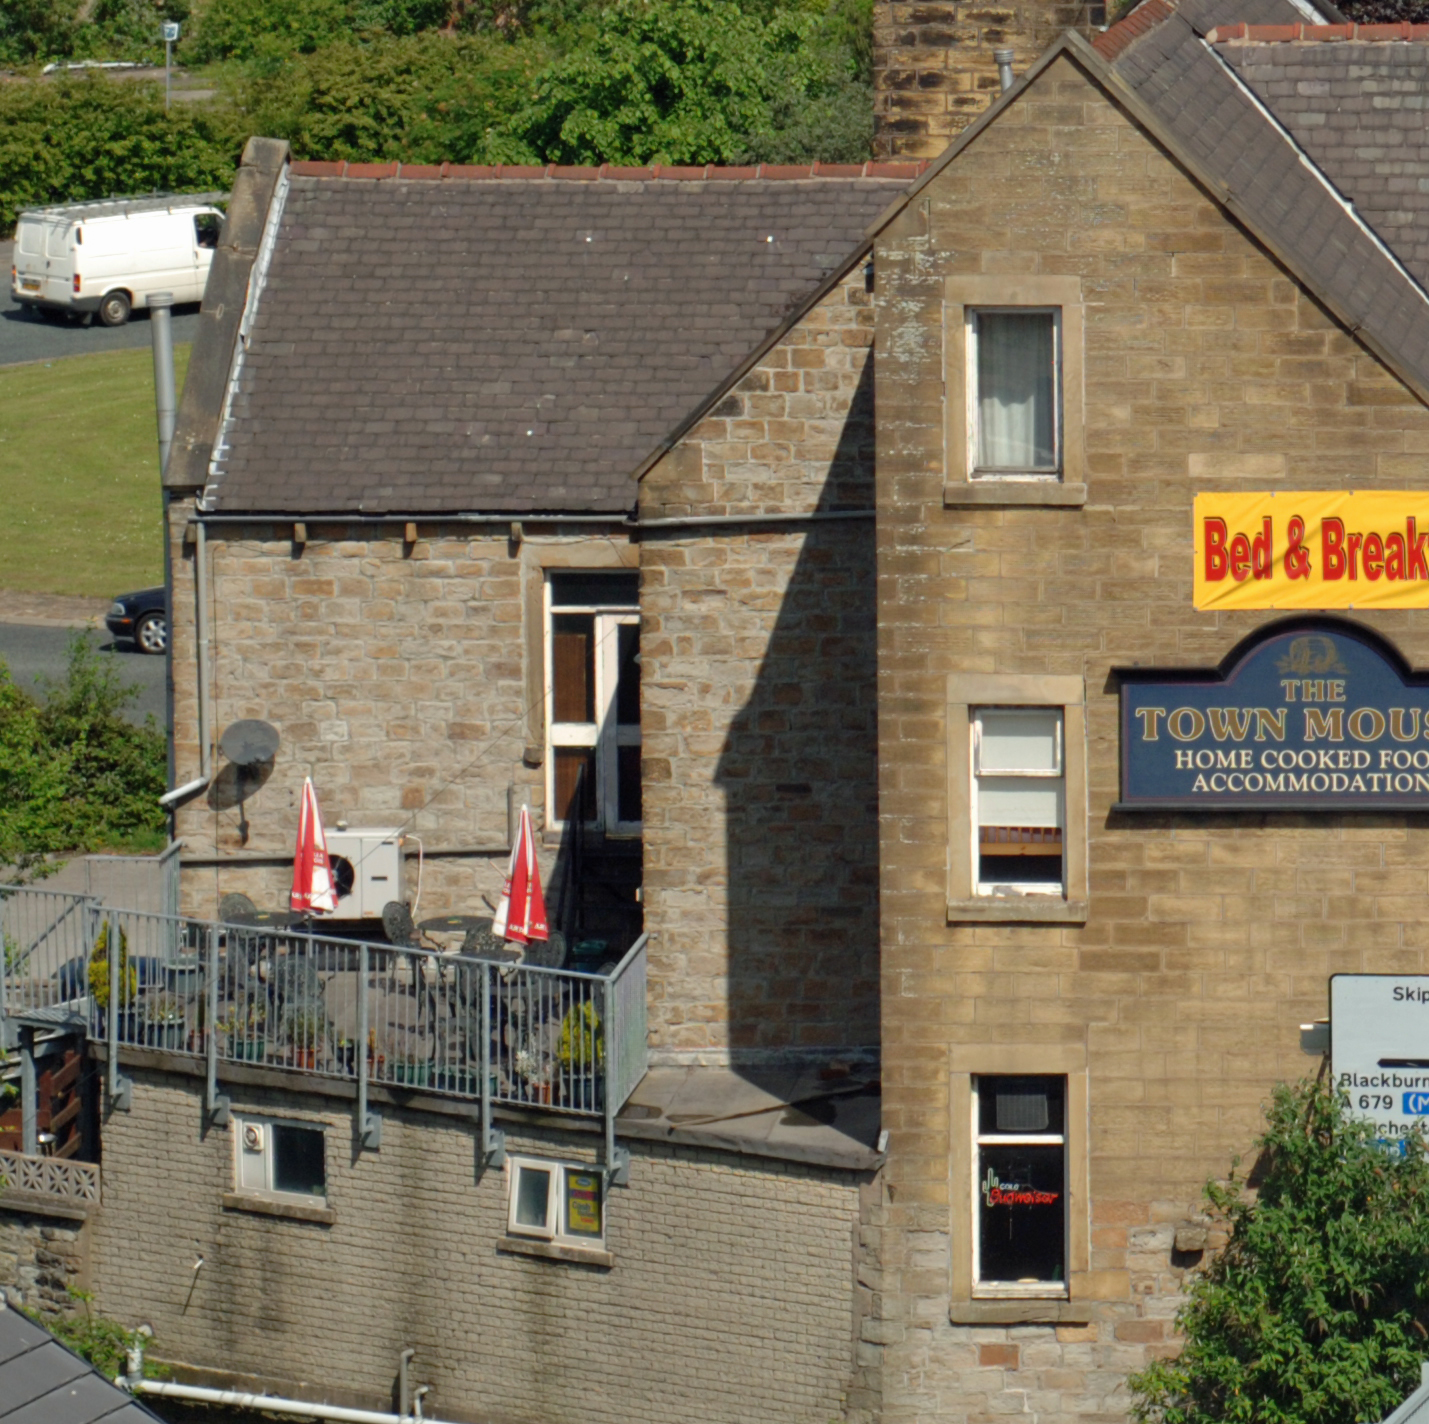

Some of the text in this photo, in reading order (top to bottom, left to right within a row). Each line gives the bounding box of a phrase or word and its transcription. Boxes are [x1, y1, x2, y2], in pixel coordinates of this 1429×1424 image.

[1203, 516, 1273, 582] Bed
[1284, 515, 1312, 581] &
[1281, 679, 1346, 702] THE
[1135, 706, 1287, 741] TOWN
[1175, 749, 1254, 770] HOME
[1260, 749, 1372, 770] COOKED
[1340, 1095, 1353, 1109] A
[1358, 1095, 1393, 1110] 679
[989, 1187, 1059, 1205] Budweiser
[1000, 1183, 1020, 1191] COLD
